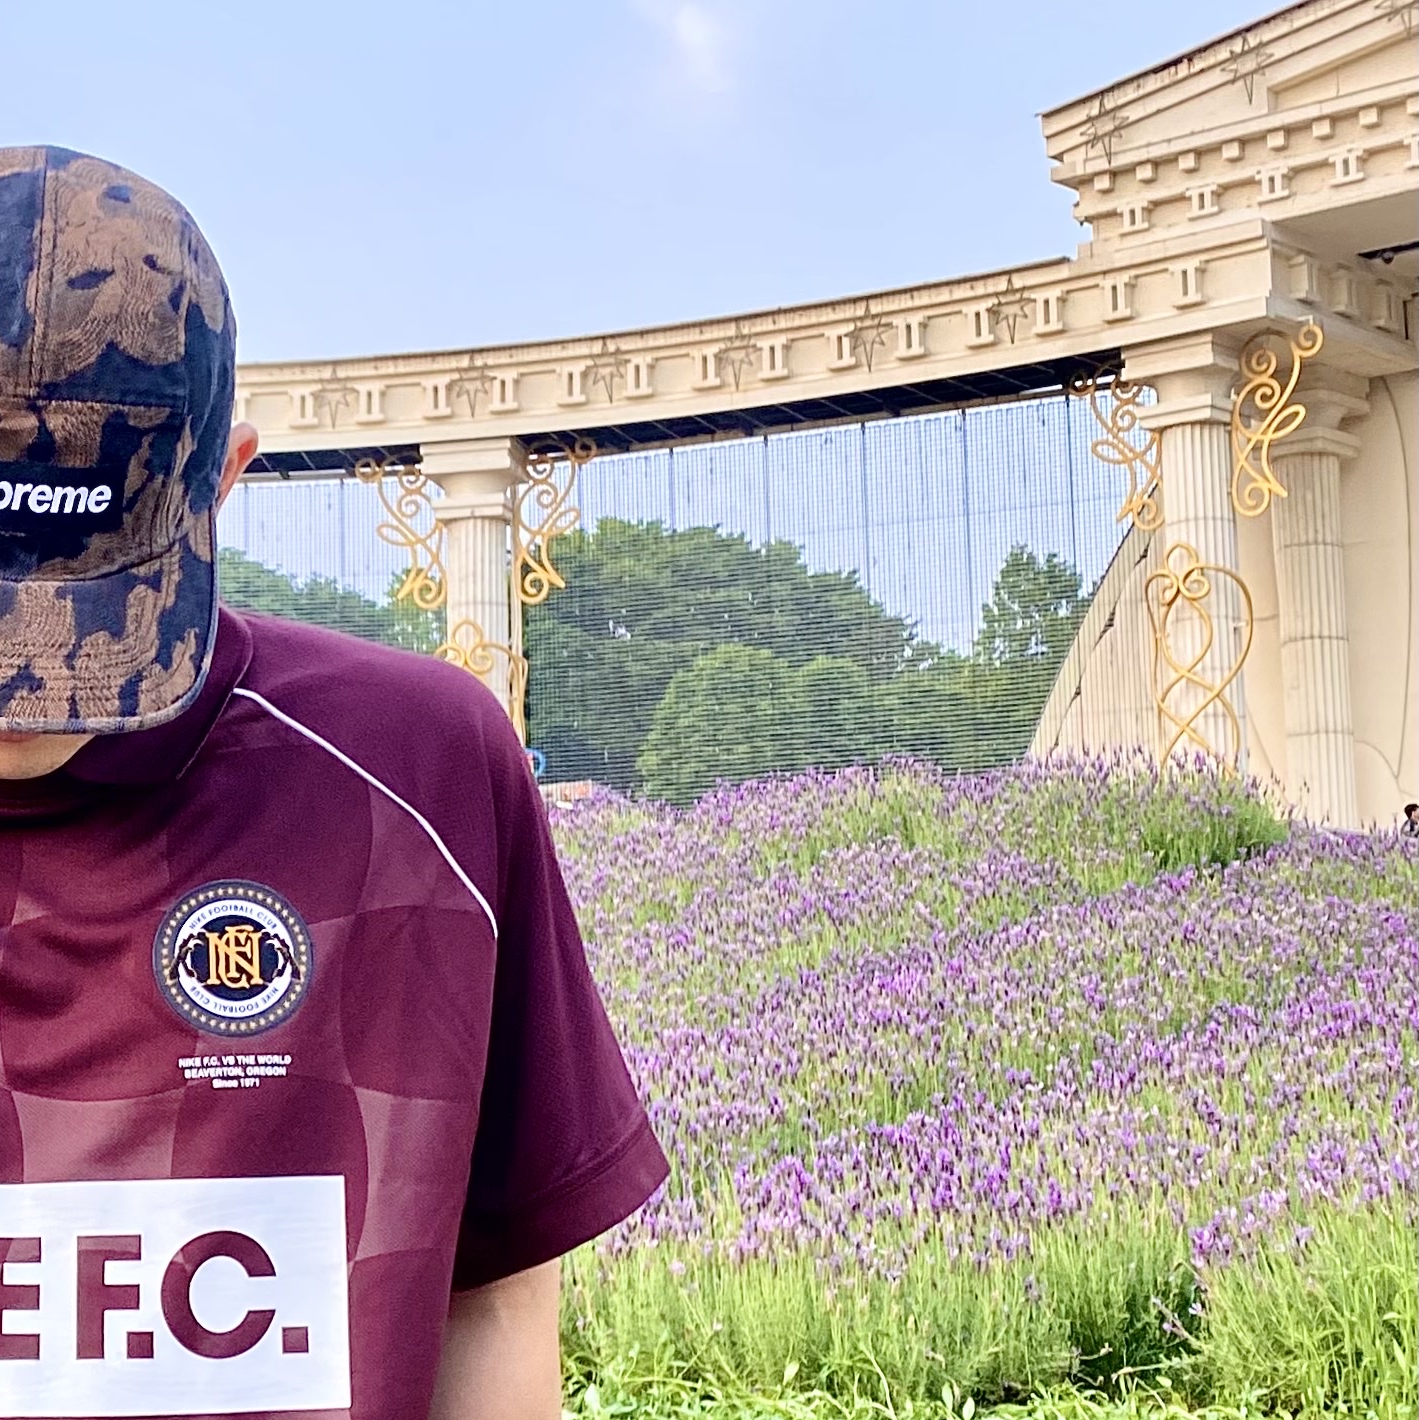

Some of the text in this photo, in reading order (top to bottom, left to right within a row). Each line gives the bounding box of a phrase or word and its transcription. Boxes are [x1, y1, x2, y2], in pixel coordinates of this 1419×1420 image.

[189, 904, 277, 929] NIKE FOOTBALL CLUB
[178, 1054, 292, 1068] NIKE F.C. VS THE WORLD
[184, 1065, 287, 1079] BEAVERTON, OREGON
[212, 1078, 239, 1089] Since
[76, 1230, 310, 1360] F.C.
